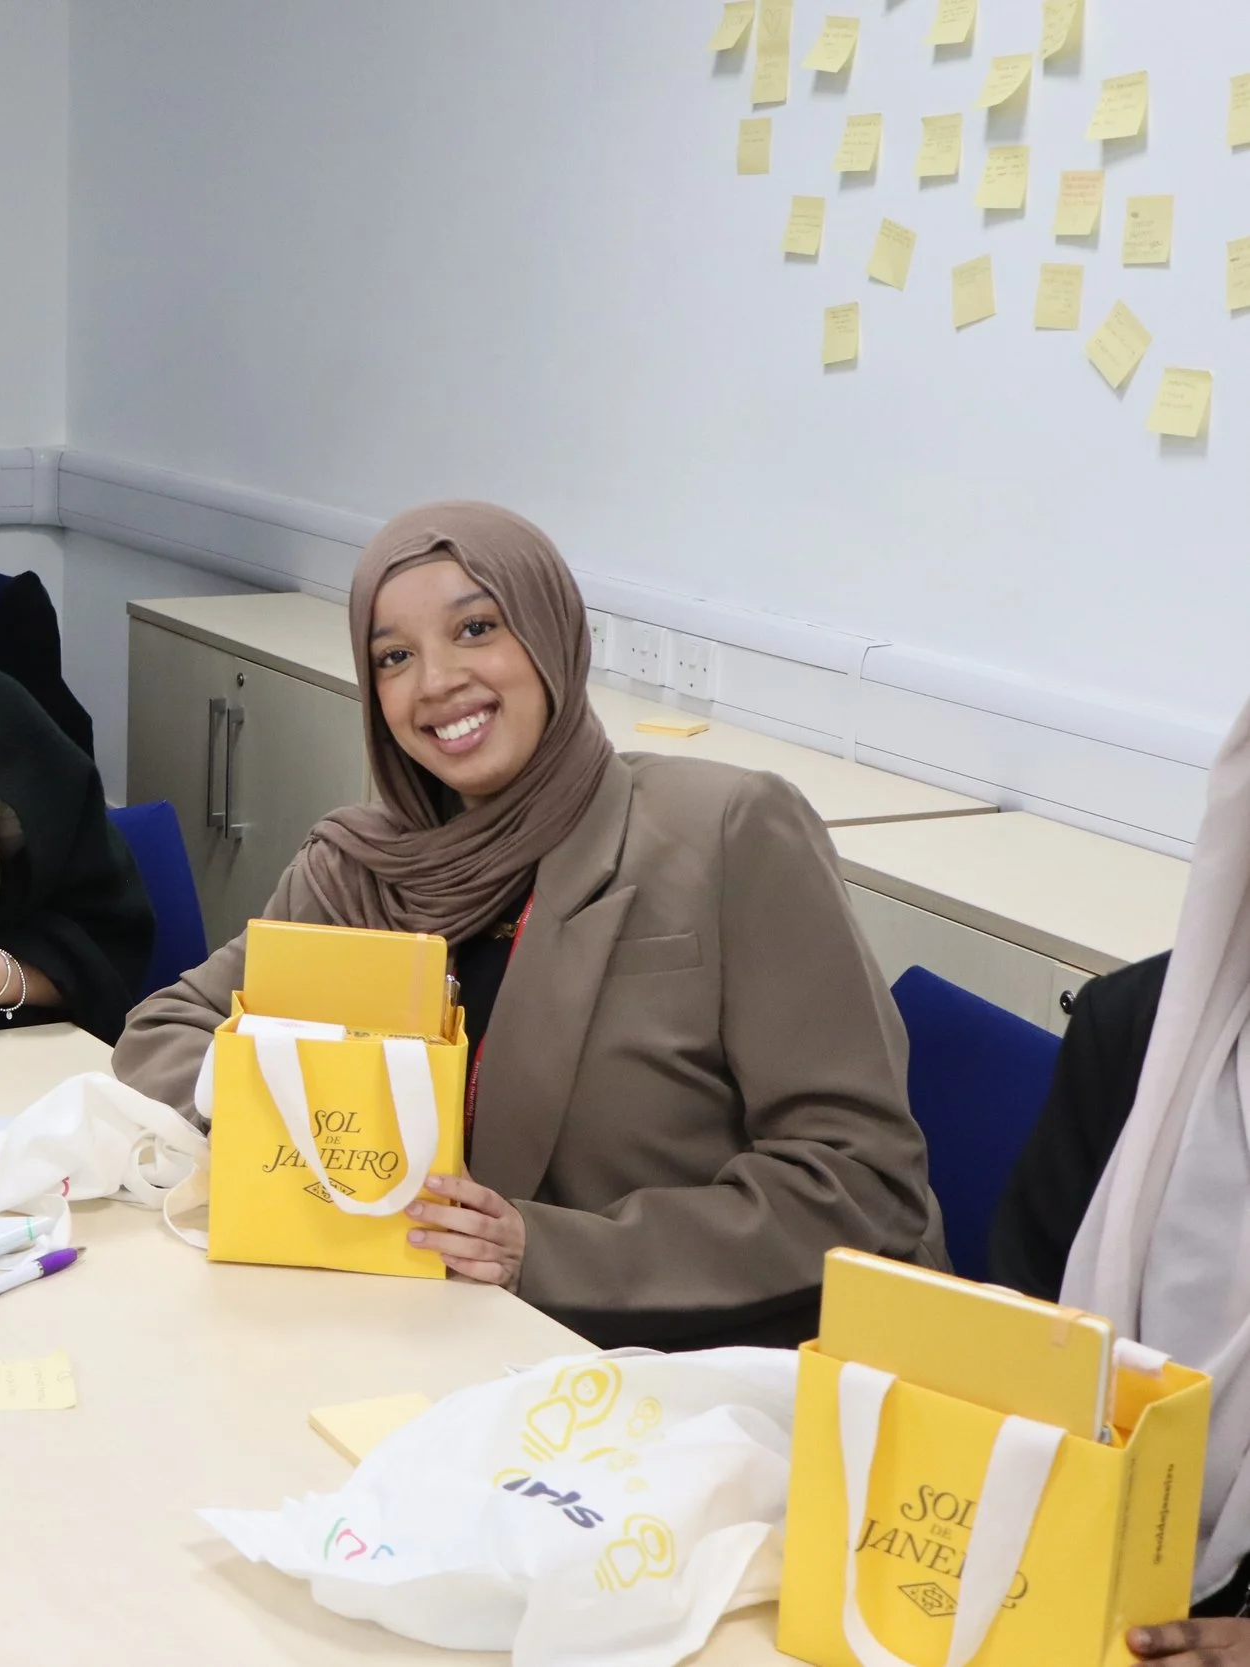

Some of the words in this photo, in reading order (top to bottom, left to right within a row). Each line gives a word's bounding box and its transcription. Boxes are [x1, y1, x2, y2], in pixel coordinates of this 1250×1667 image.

[312, 1109, 362, 1139] SOL
[325, 1135, 342, 1145] DE
[899, 1485, 978, 1530] SOL
[929, 1523, 953, 1540] DE
[847, 1517, 1029, 1610] JANEI
